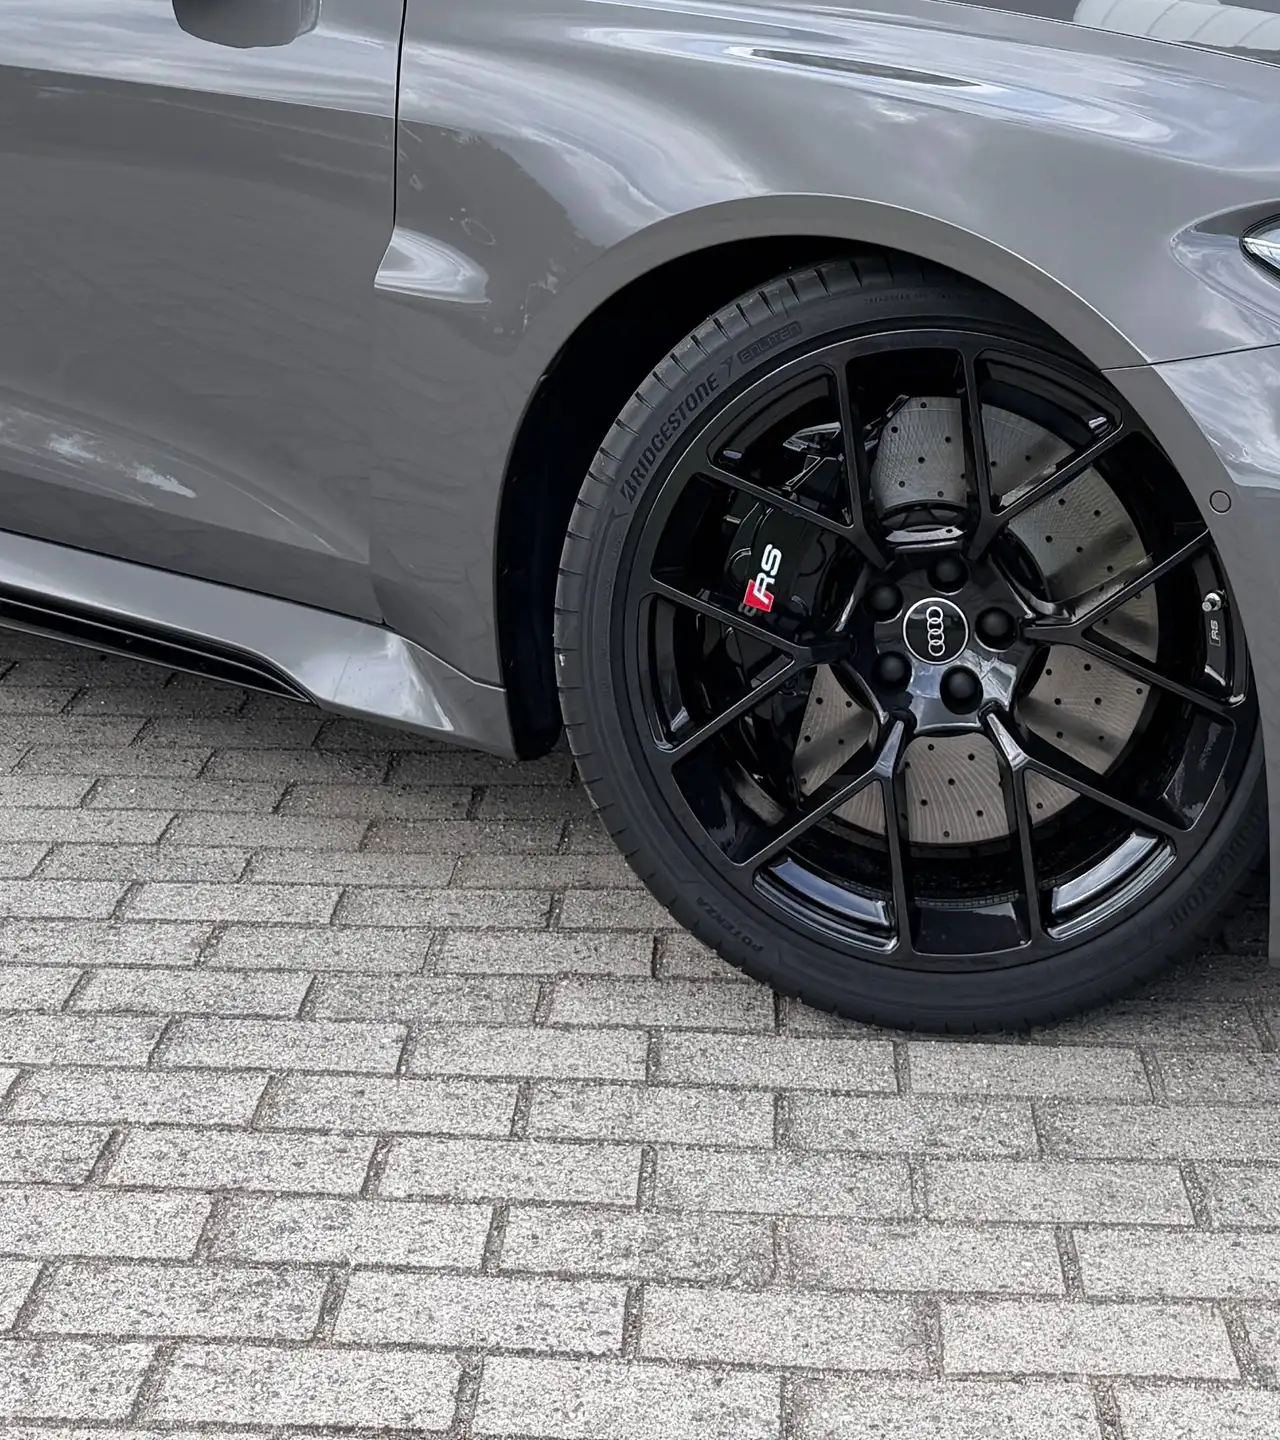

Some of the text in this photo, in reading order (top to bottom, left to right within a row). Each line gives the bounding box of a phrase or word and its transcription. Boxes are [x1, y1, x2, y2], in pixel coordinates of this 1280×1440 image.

[621, 372, 720, 504] BRIDGESTONE
[750, 544, 782, 606] RS
[1210, 620, 1219, 641] RS
[696, 897, 765, 954] POTENZA
